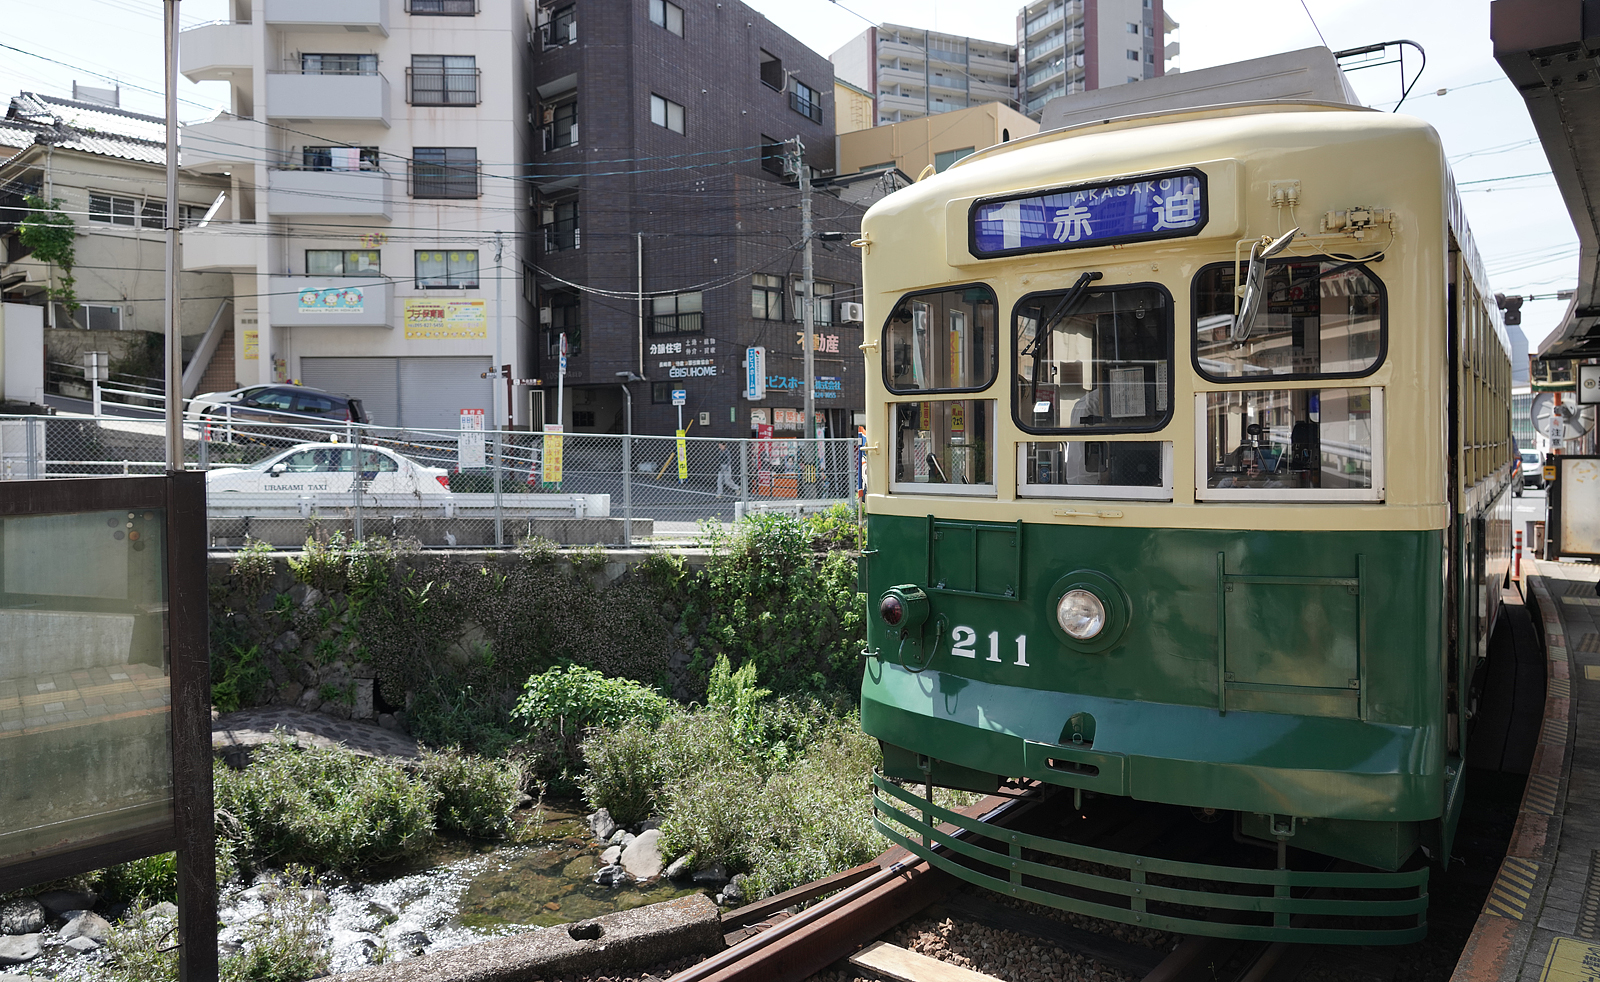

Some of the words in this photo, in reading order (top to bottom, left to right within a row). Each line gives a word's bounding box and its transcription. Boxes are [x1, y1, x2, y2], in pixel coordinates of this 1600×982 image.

[1074, 178, 1172, 203] AKASAKO
[987, 200, 1022, 250] 1
[796, 331, 840, 353] 不動産
[951, 625, 1030, 667] 211
